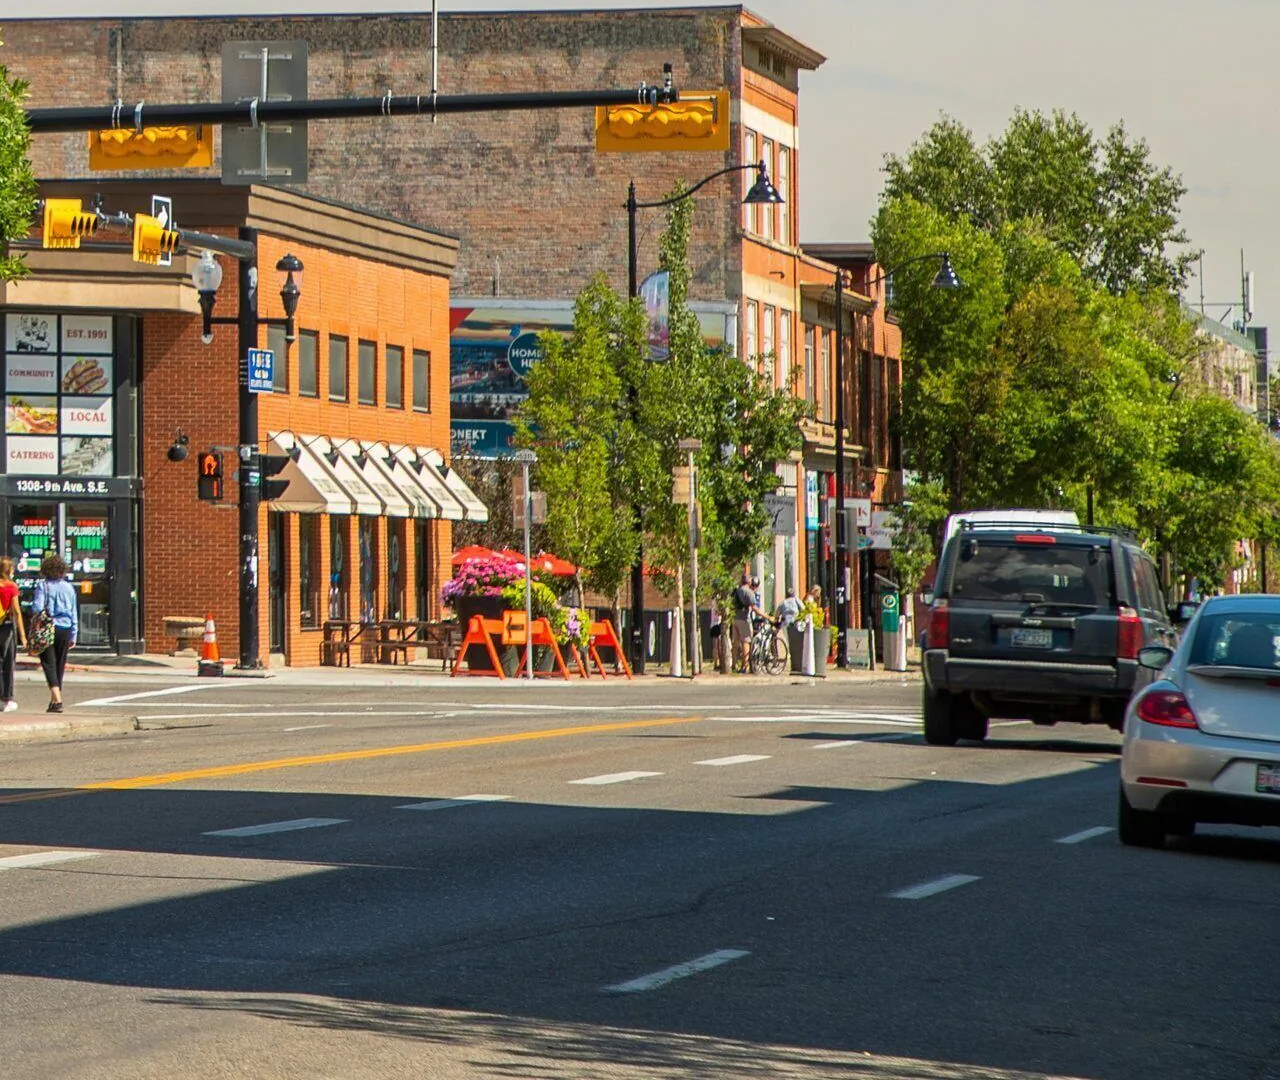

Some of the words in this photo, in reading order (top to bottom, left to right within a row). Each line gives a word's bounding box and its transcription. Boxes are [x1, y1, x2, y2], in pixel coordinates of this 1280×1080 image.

[66, 330, 86, 339] EST.
[88, 330, 108, 340] 1991
[9, 369, 54, 378] COMMUNITY
[70, 411, 107, 422] LOCAL
[450, 429, 488, 441] ONEKT
[10, 450, 55, 460] CATERING
